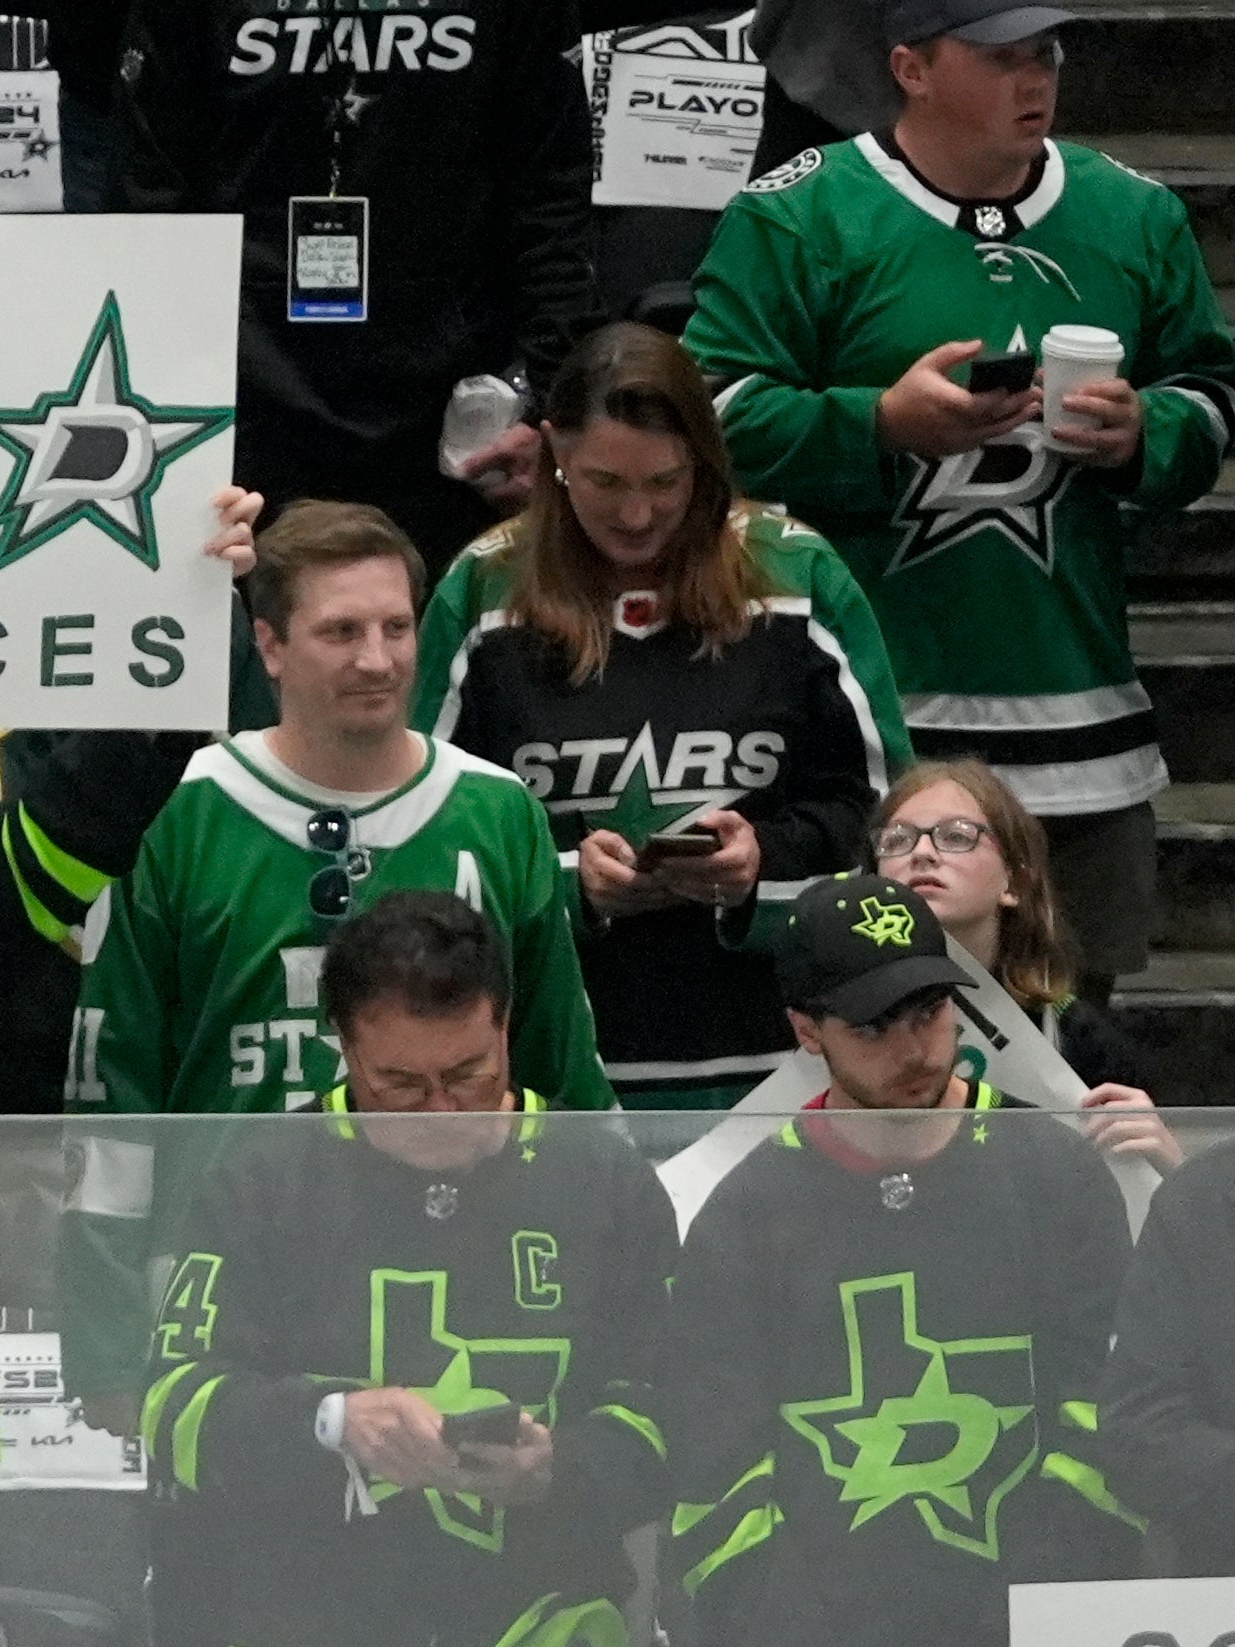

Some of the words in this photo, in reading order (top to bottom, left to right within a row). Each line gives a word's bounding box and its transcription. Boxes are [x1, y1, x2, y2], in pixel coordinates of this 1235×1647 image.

[229, 14, 477, 75] STARS
[513, 719, 786, 799] STARS
[511, 1229, 562, 1310] C
